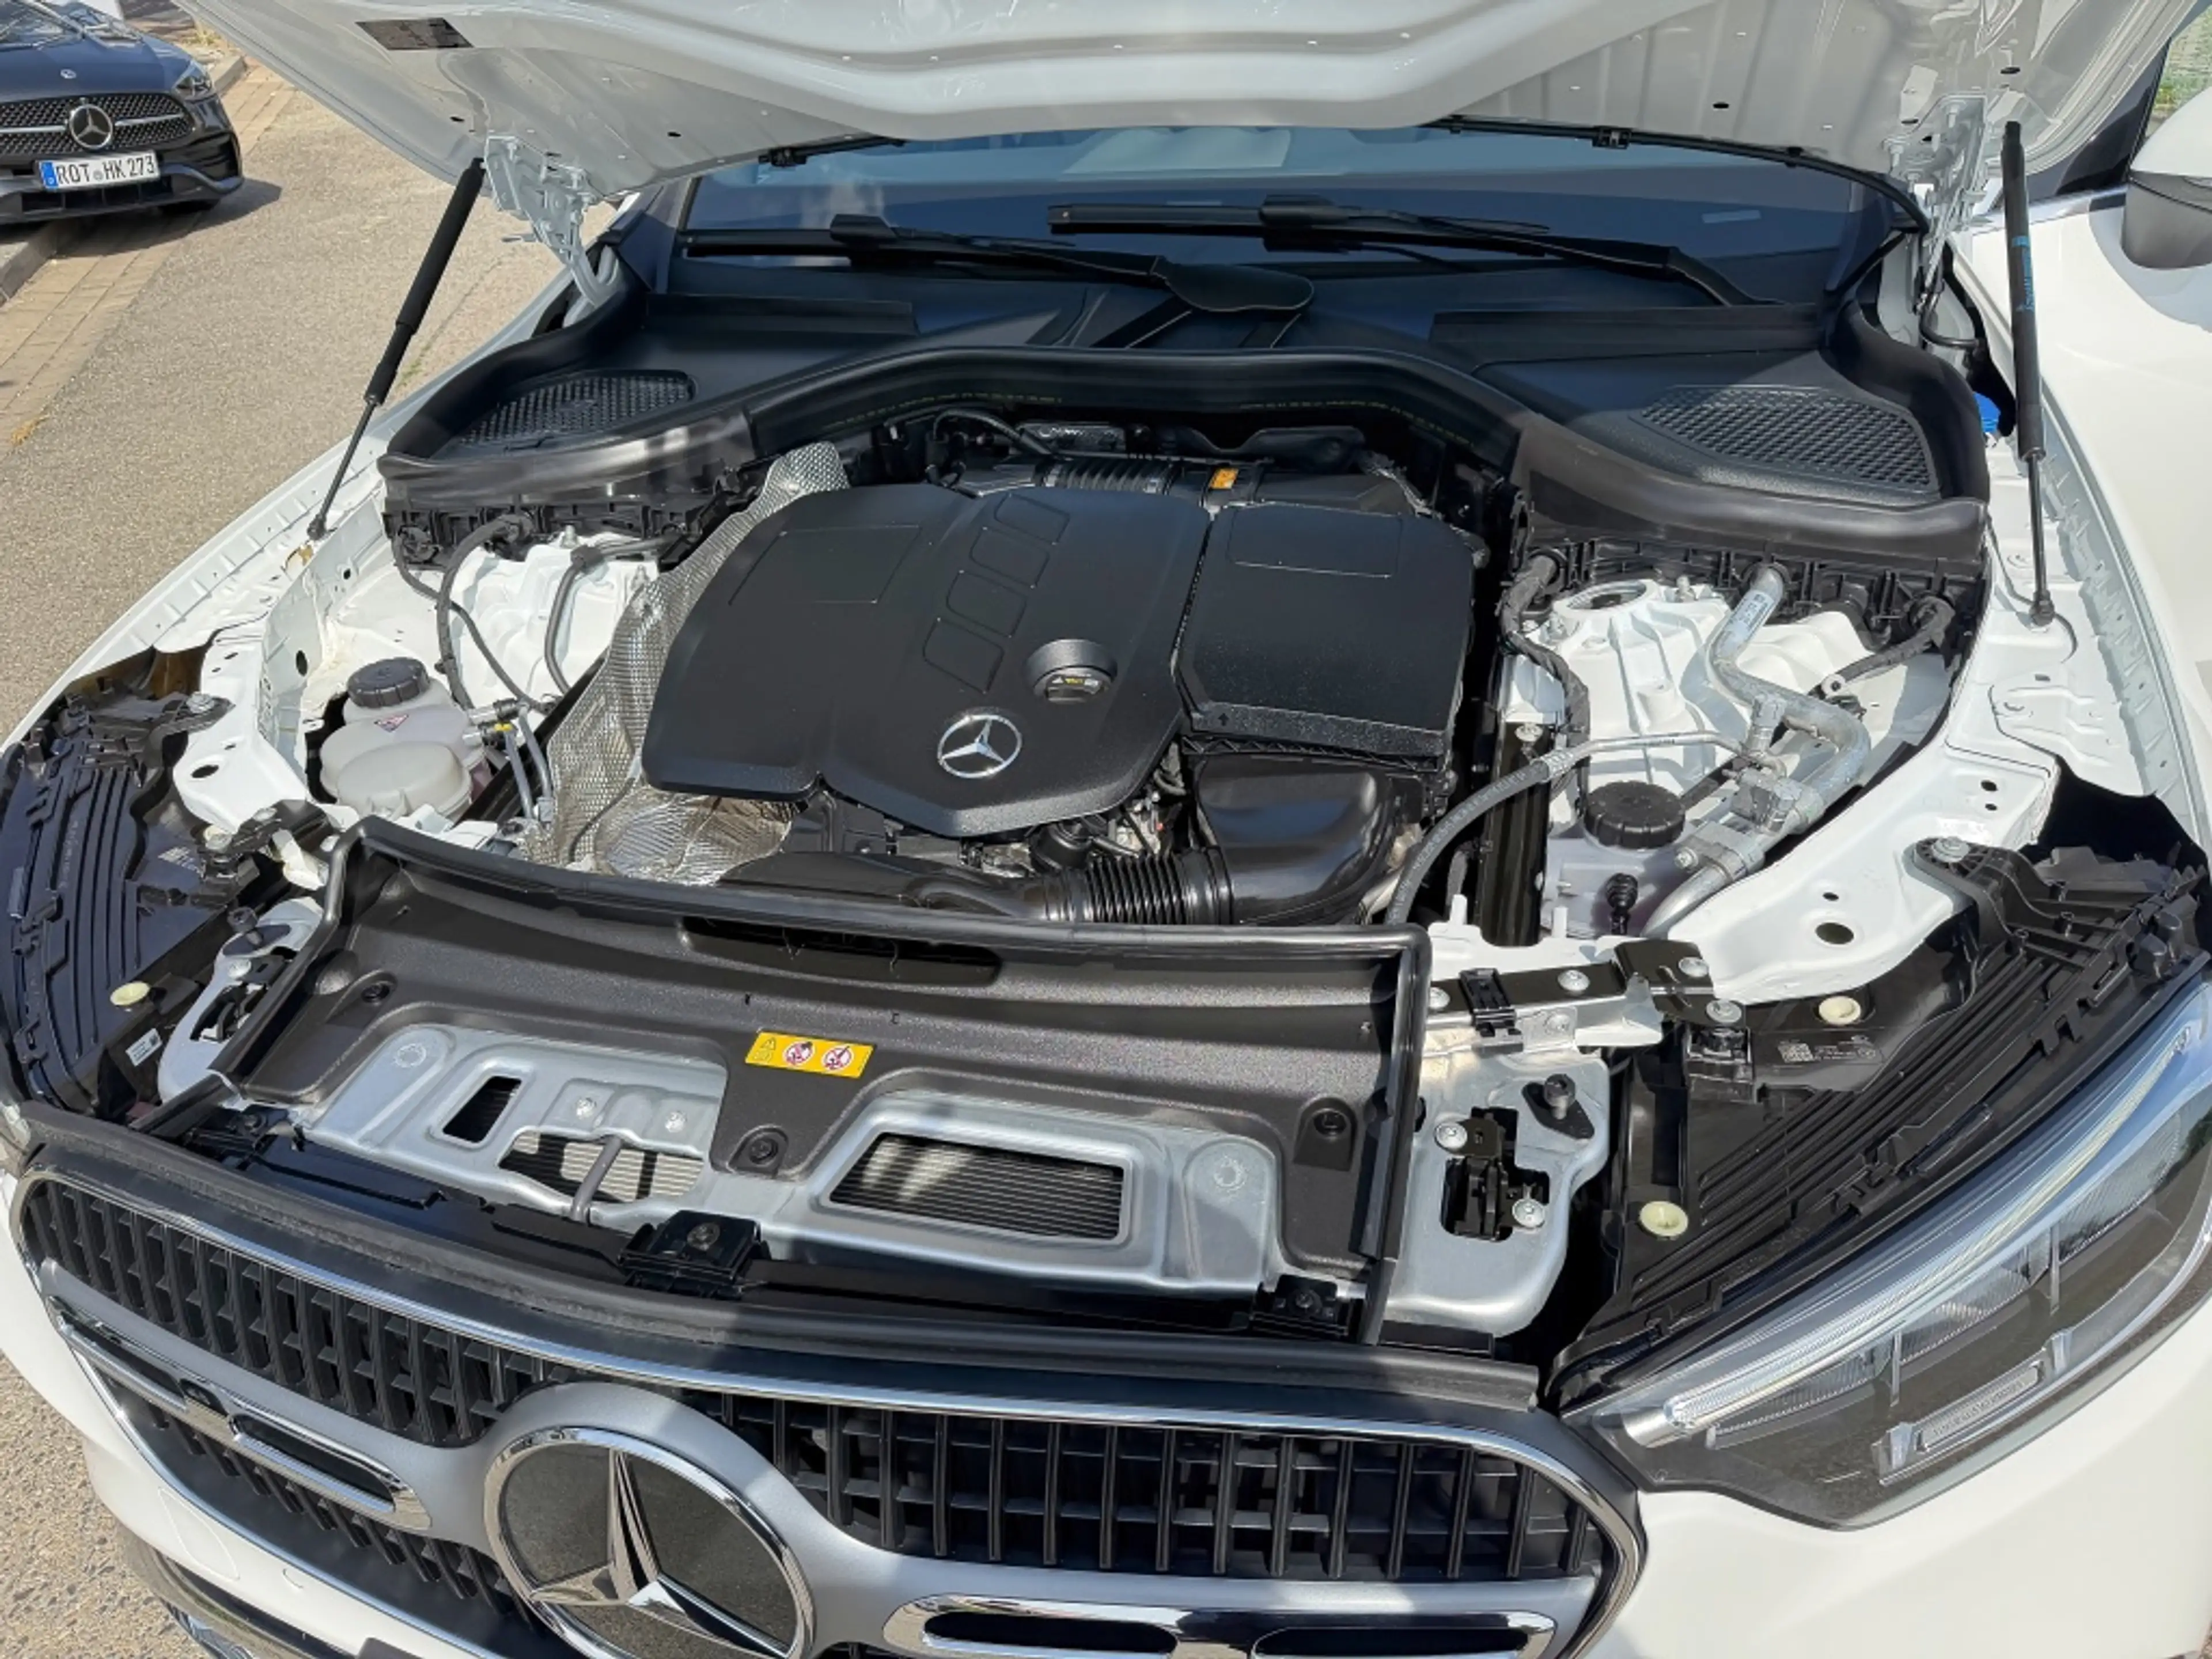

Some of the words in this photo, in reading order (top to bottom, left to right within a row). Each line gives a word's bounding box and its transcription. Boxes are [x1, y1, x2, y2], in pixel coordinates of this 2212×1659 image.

[56, 164, 90, 184] ROT
[102, 159, 126, 180] HK
[127, 155, 154, 176] 273
